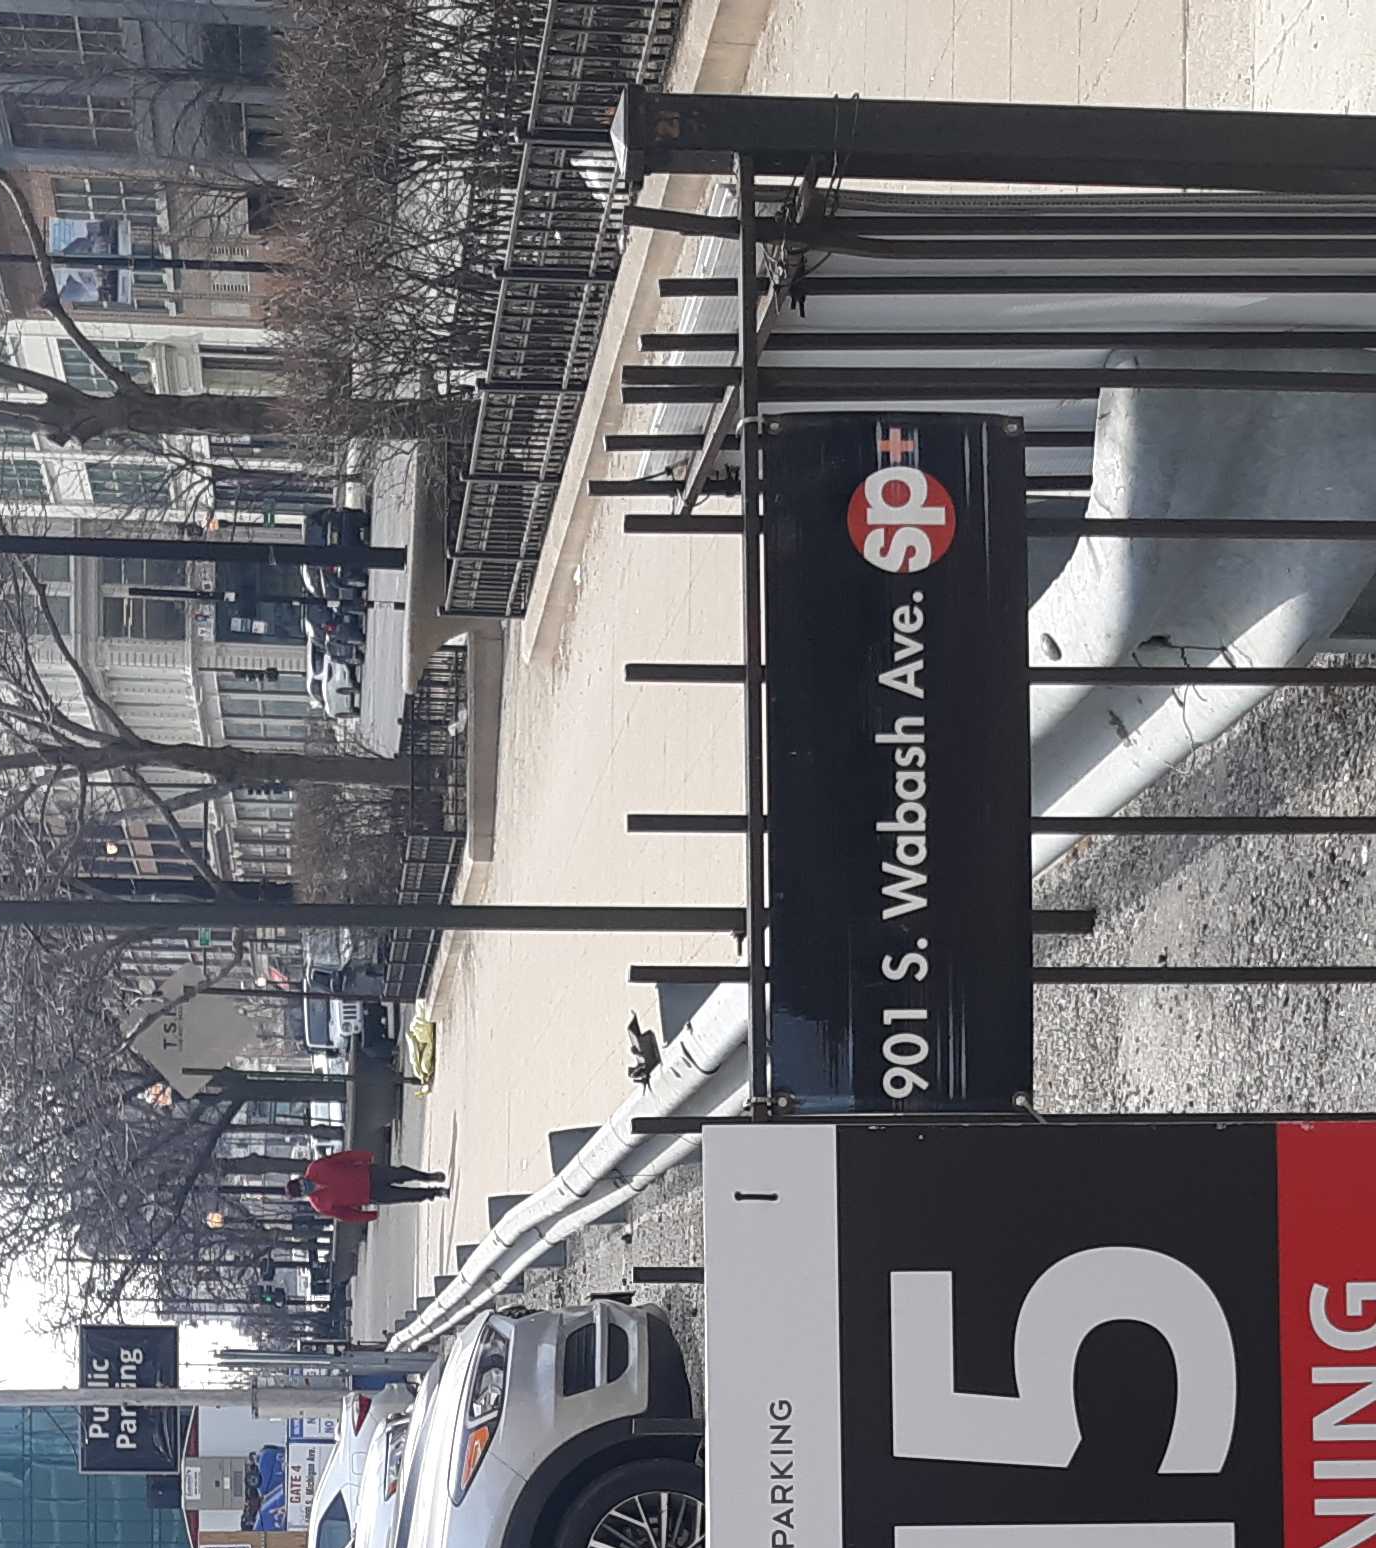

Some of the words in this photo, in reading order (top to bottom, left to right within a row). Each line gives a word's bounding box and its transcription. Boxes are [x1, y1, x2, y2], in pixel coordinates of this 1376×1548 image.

[879, 591, 925, 698] Ave.
[875, 717, 928, 920] Wabash
[882, 938, 928, 981] S.
[882, 1008, 928, 1098] 901
[87, 1358, 110, 1439] Pulic
[115, 1346, 143, 1449] Paring
[289, 1464, 302, 1473] 4
[289, 1475, 302, 1504] GATE
[306, 1463, 316, 1496] Michigan
[770, 1399, 794, 1548] PARKING
